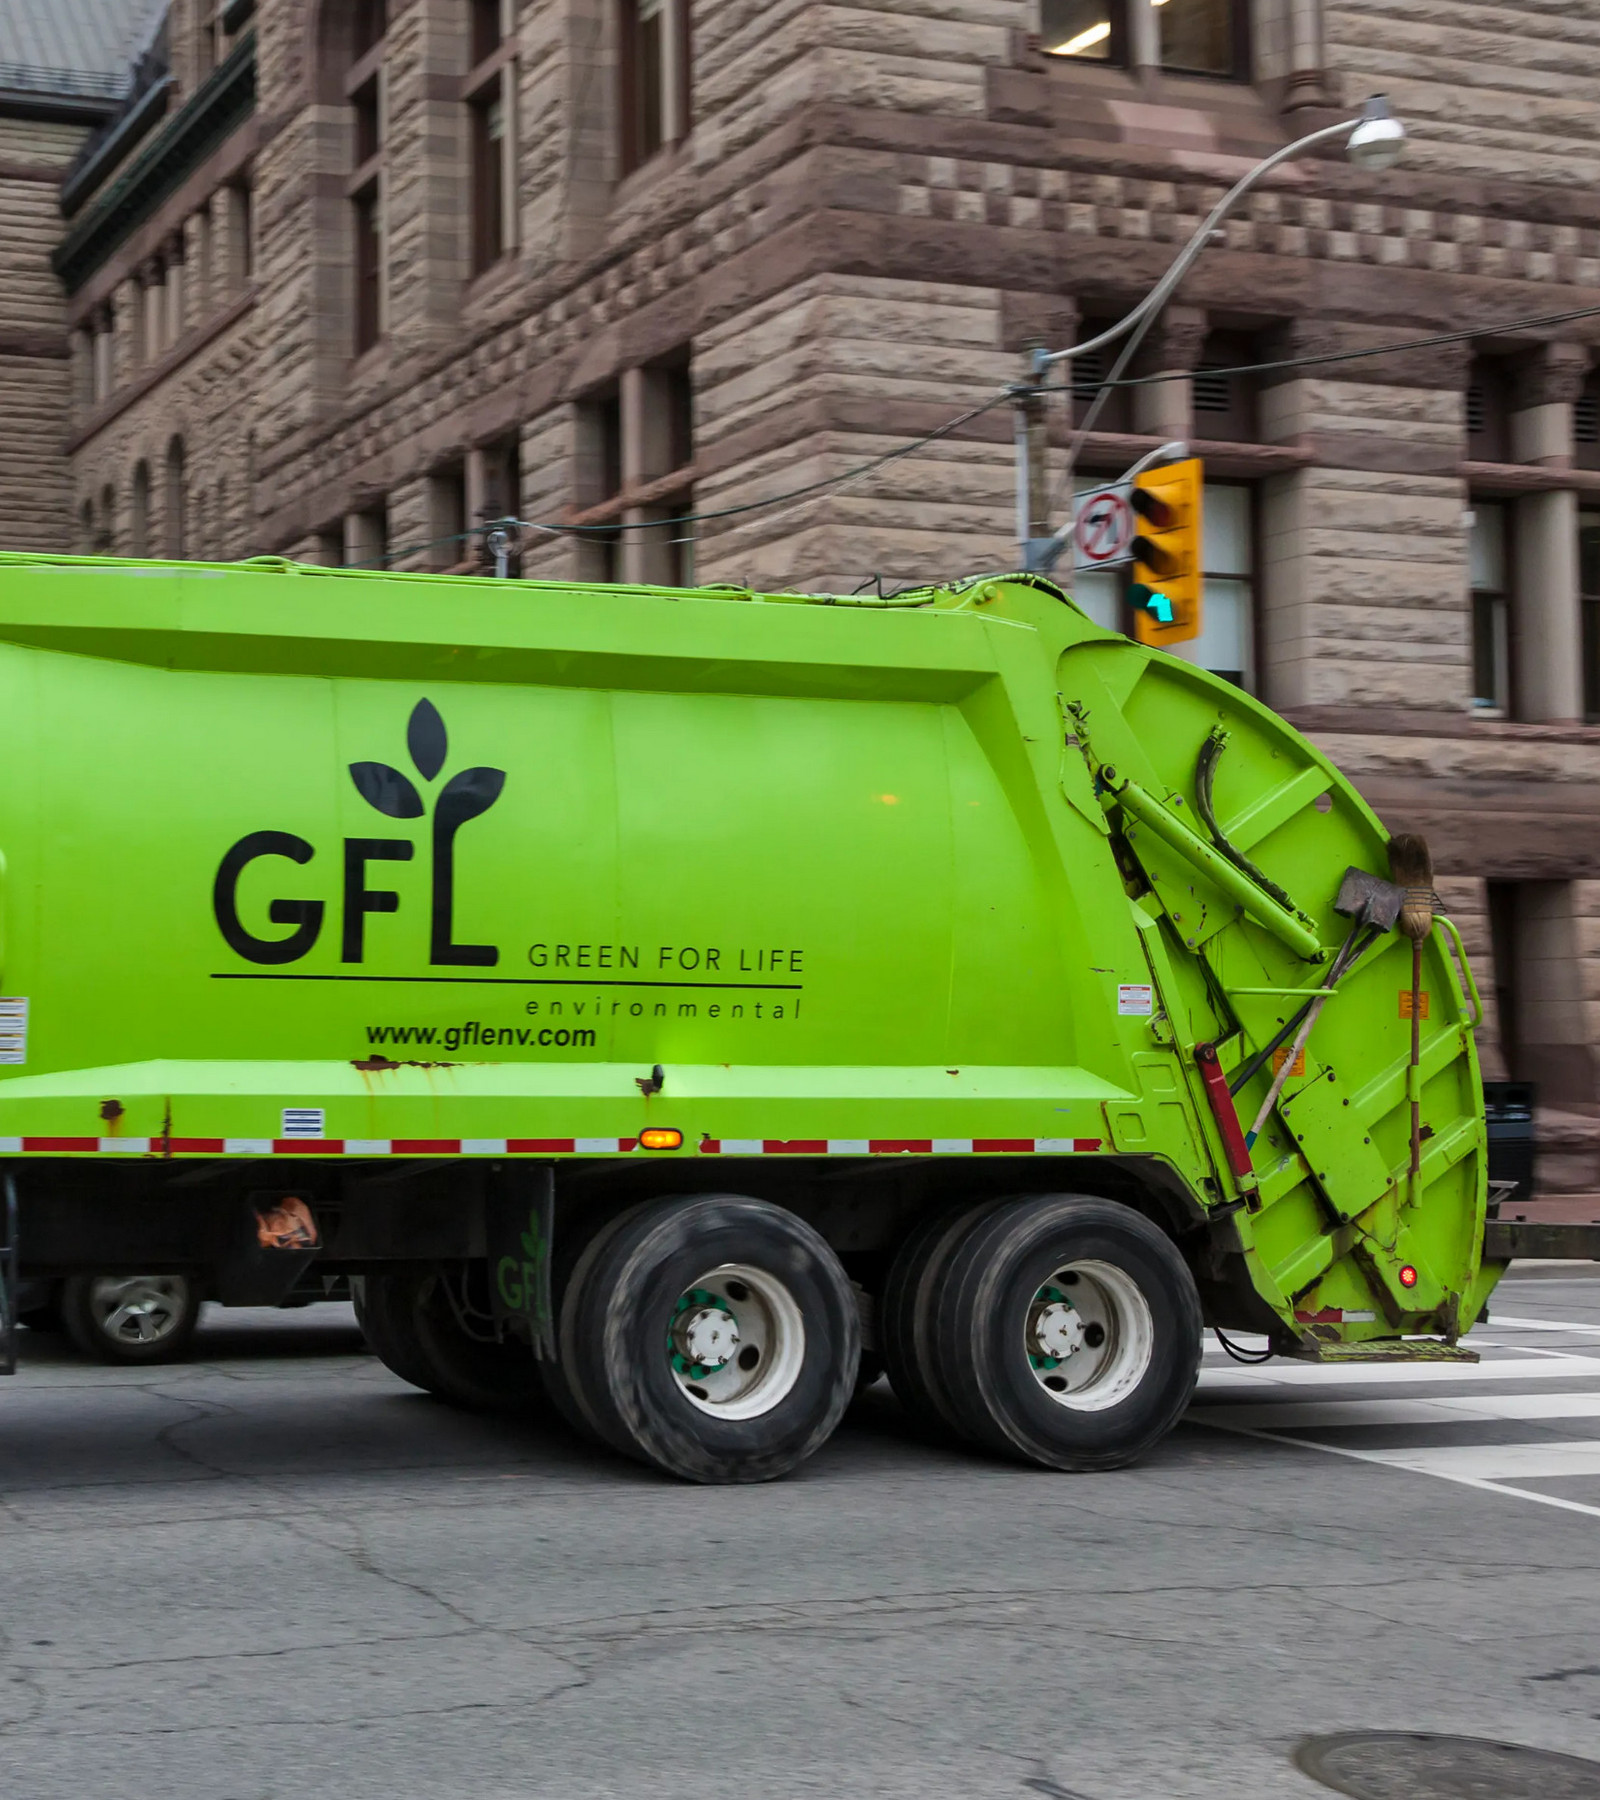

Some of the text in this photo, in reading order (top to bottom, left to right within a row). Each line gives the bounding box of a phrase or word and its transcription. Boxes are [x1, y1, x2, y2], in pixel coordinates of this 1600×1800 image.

[212, 764, 507, 968] GFL
[527, 943, 804, 972] GREEN FOR LIFE
[524, 996, 801, 1020] environmental
[366, 1021, 597, 1051] www.gflenv.com
